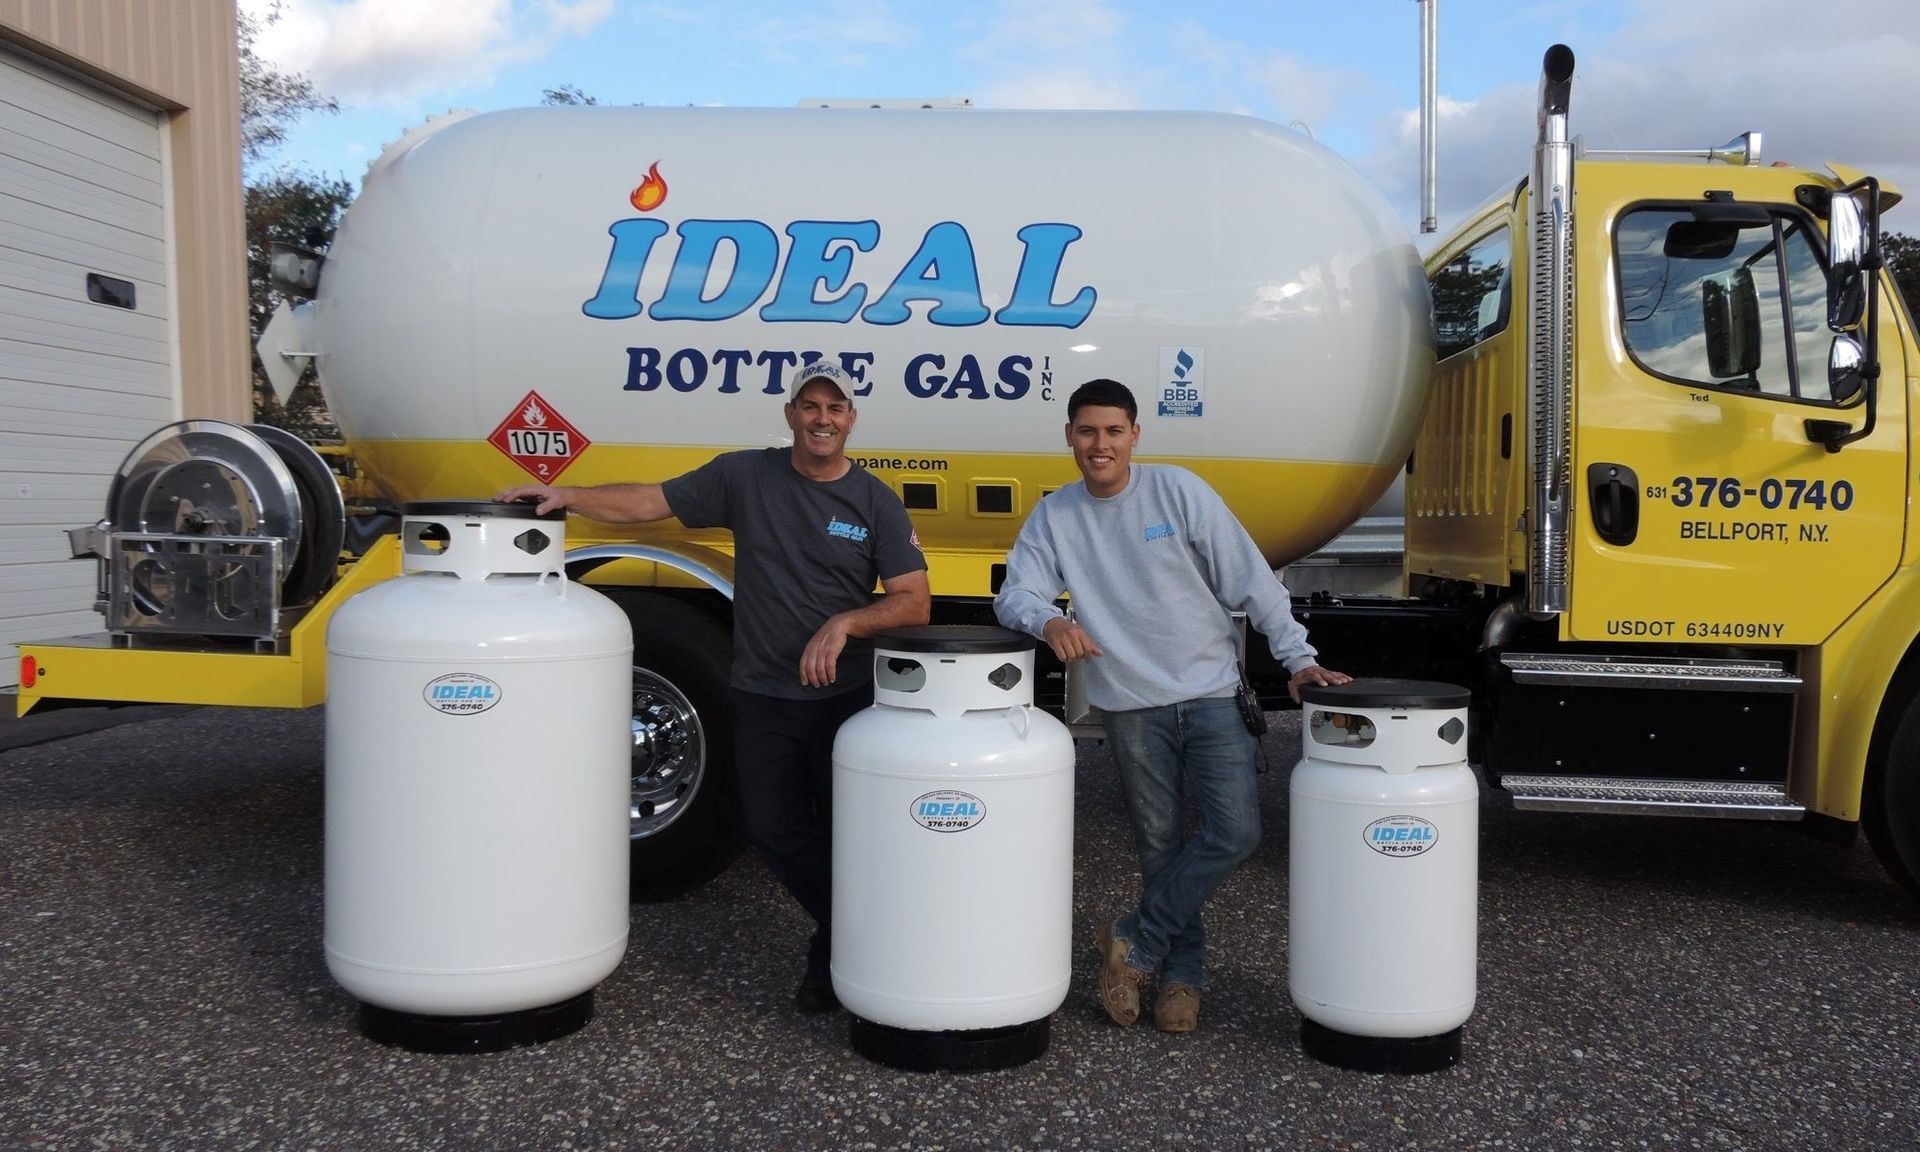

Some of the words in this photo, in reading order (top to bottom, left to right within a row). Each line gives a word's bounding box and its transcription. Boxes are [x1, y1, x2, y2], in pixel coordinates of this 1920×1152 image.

[582, 218, 1097, 329] IDEAL
[904, 353, 1033, 400] GAS
[1041, 356, 1055, 401] INC.
[1164, 389, 1198, 401] BBB
[1689, 393, 1709, 402] Ted
[511, 431, 567, 455] 1075
[538, 463, 549, 475] 2
[1646, 486, 1667, 498] 631
[1671, 476, 1854, 511] 376-0740
[827, 520, 868, 538] IDEAL
[1680, 521, 1788, 544] BELLPORT,
[1799, 524, 1829, 542] N.Y.
[1607, 620, 1675, 636] USDOT
[1686, 622, 1785, 638] 634409NY
[432, 685, 494, 699] IDEAL
[918, 802, 979, 816] IDEAL
[1373, 827, 1432, 841] IDEAL
